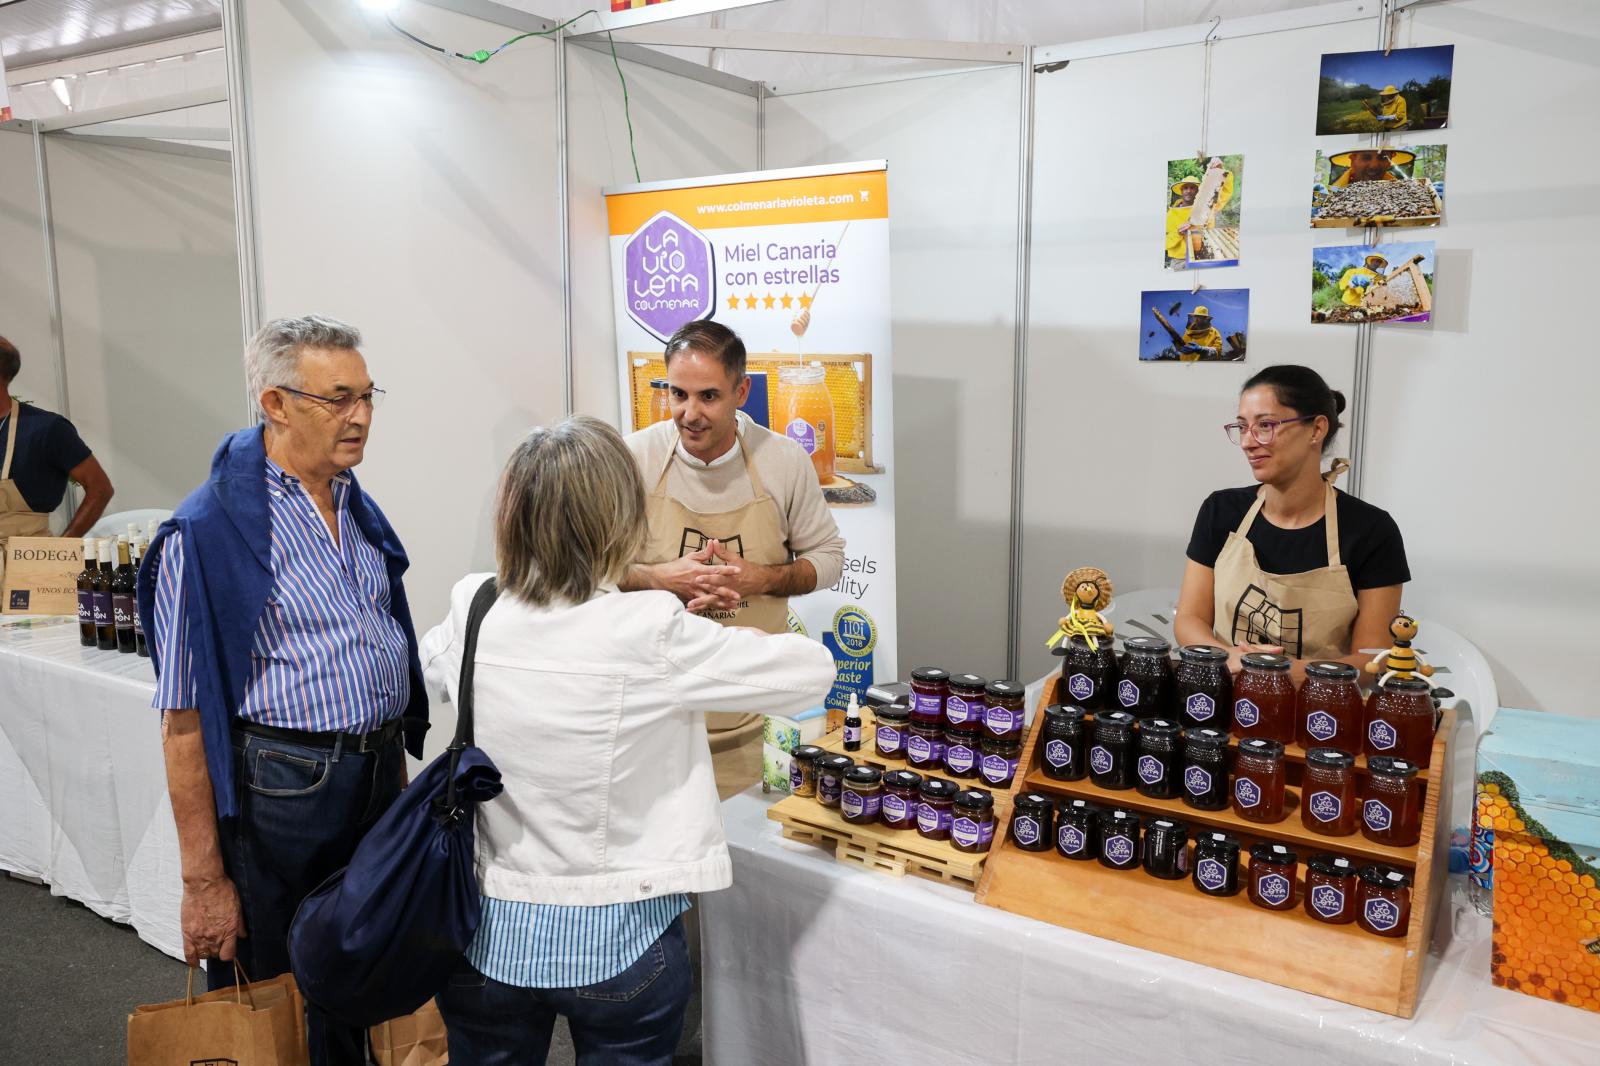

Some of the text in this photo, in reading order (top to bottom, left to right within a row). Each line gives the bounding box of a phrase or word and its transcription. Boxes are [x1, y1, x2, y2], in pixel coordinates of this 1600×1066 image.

[646, 229, 678, 252] LA
[724, 239, 837, 263] Miel Canaria
[725, 265, 840, 286] con estrellas
[14, 549, 78, 561] BODEGA
[843, 555, 877, 574] sels
[846, 638, 864, 648] 2018
[834, 658, 871, 671] uperior
[826, 696, 849, 708] SOMM
[836, 691, 851, 701] CHE
